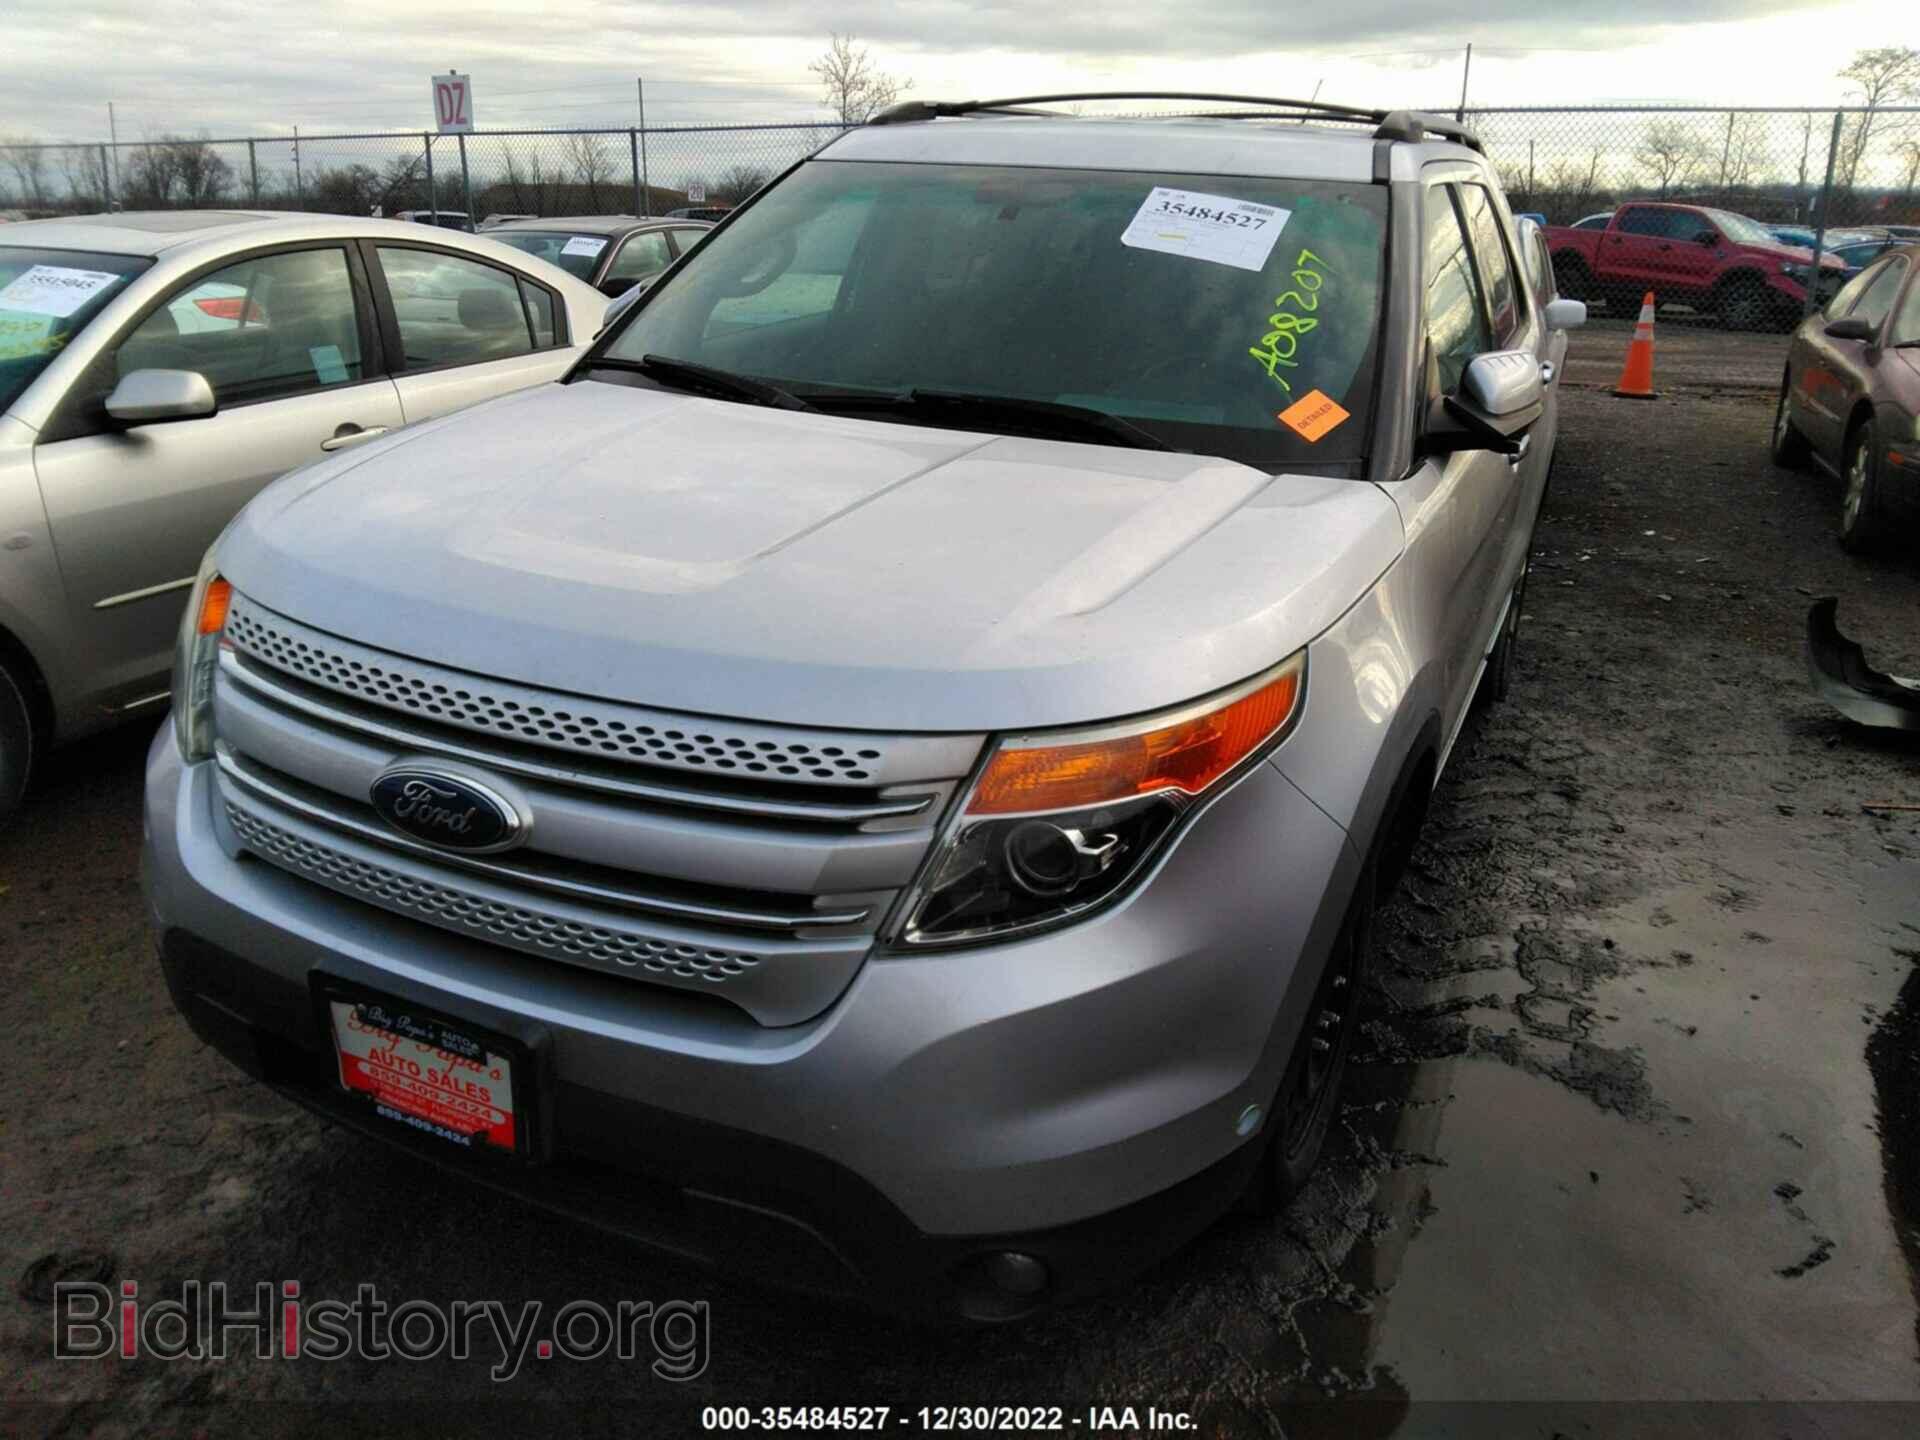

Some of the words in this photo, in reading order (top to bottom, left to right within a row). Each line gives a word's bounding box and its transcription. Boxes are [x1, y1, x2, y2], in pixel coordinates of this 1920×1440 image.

[436, 82, 468, 125] DZ
[1154, 199, 1268, 232] 35484527
[1296, 403, 1334, 430] DETAILED
[393, 780, 477, 834] Ford
[367, 1046, 421, 1077] AUTO
[427, 1066, 493, 1104] SALES
